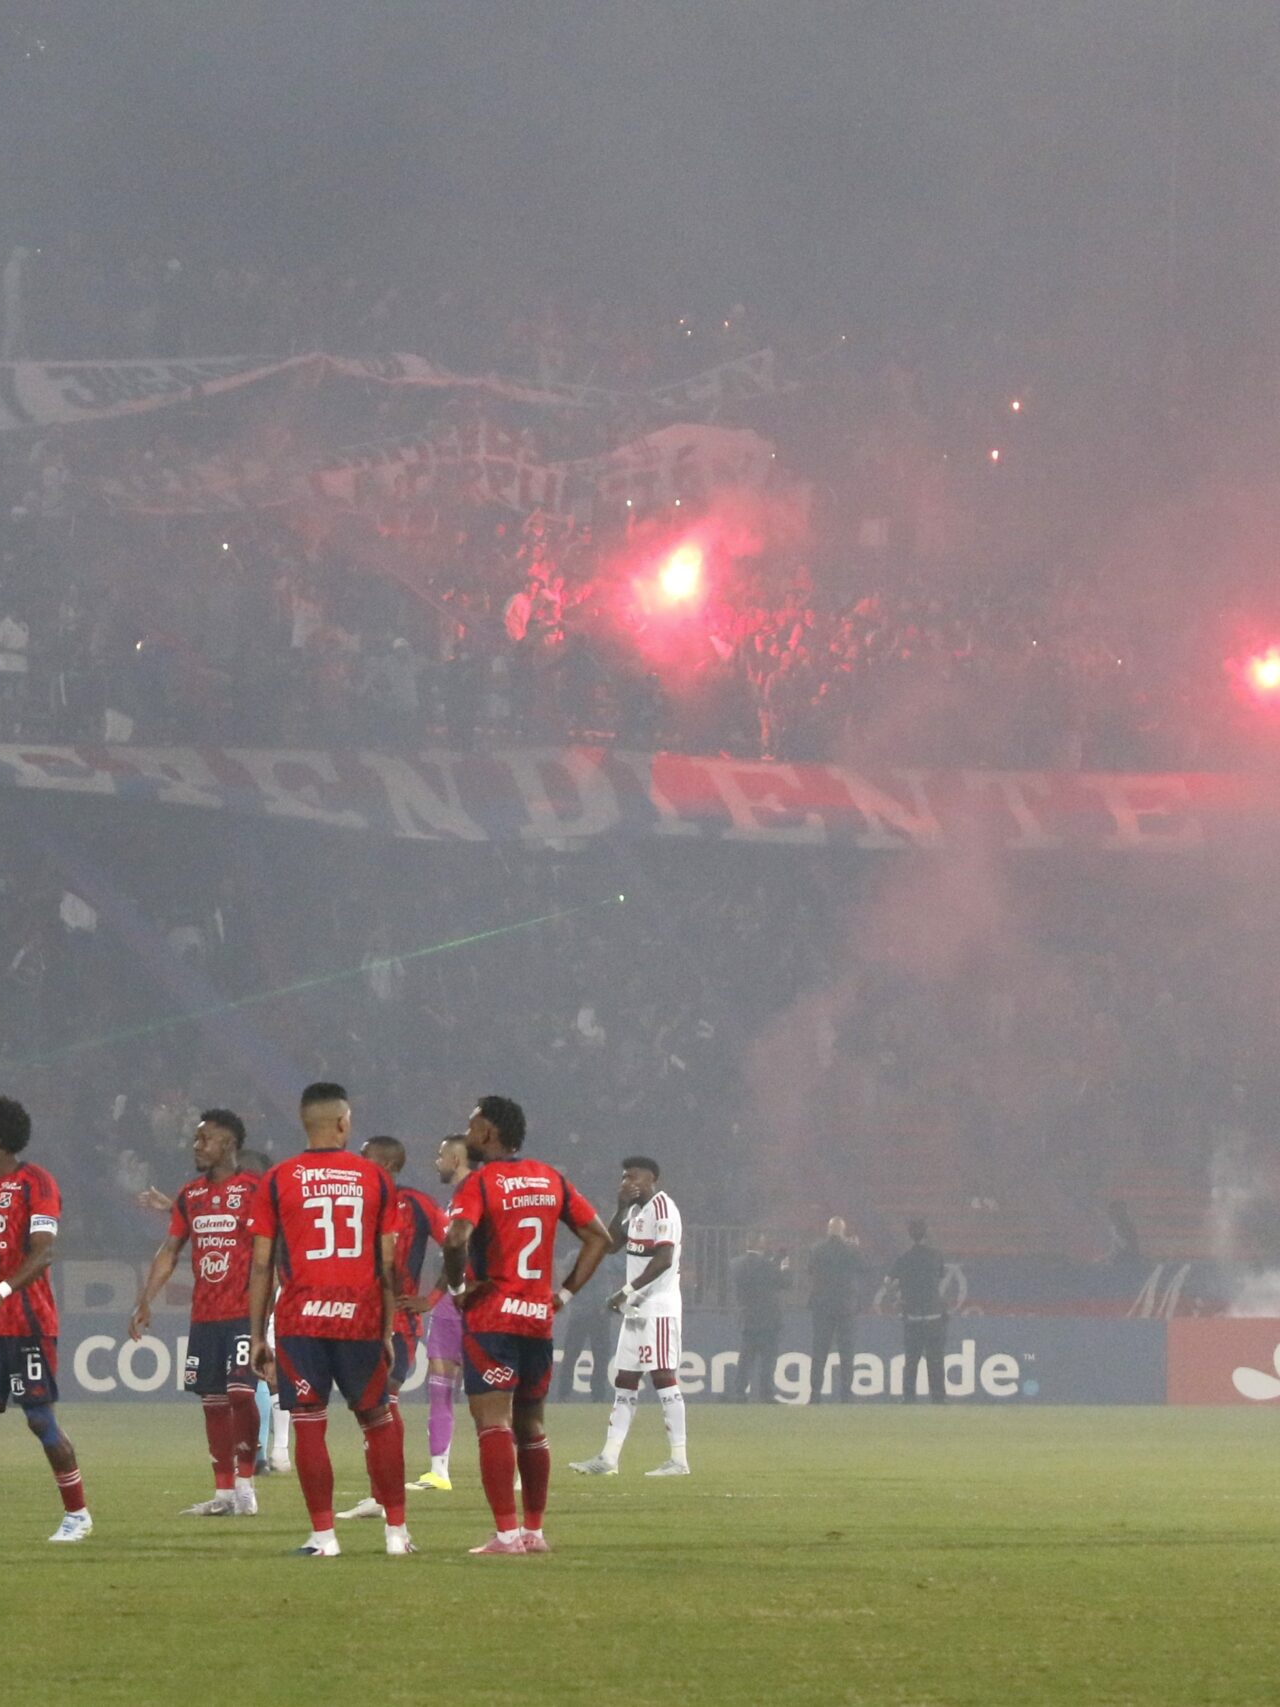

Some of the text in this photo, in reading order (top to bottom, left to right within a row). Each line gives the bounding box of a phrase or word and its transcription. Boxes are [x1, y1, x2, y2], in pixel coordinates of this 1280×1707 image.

[302, 1168, 326, 1184] JFK
[504, 1177, 527, 1193] JFK
[314, 1182, 363, 1196] LONDOÑO
[194, 1218, 235, 1230] Colanta
[302, 1196, 364, 1260] 33
[517, 1217, 543, 1279] 2
[200, 1251, 231, 1278] Pool
[302, 1300, 356, 1319] MAPEI
[501, 1297, 548, 1320] MAPEI
[236, 1340, 250, 1366] 8
[638, 1346, 653, 1364] 22
[26, 1353, 42, 1380] 6
[773, 1340, 1020, 1404] grande
